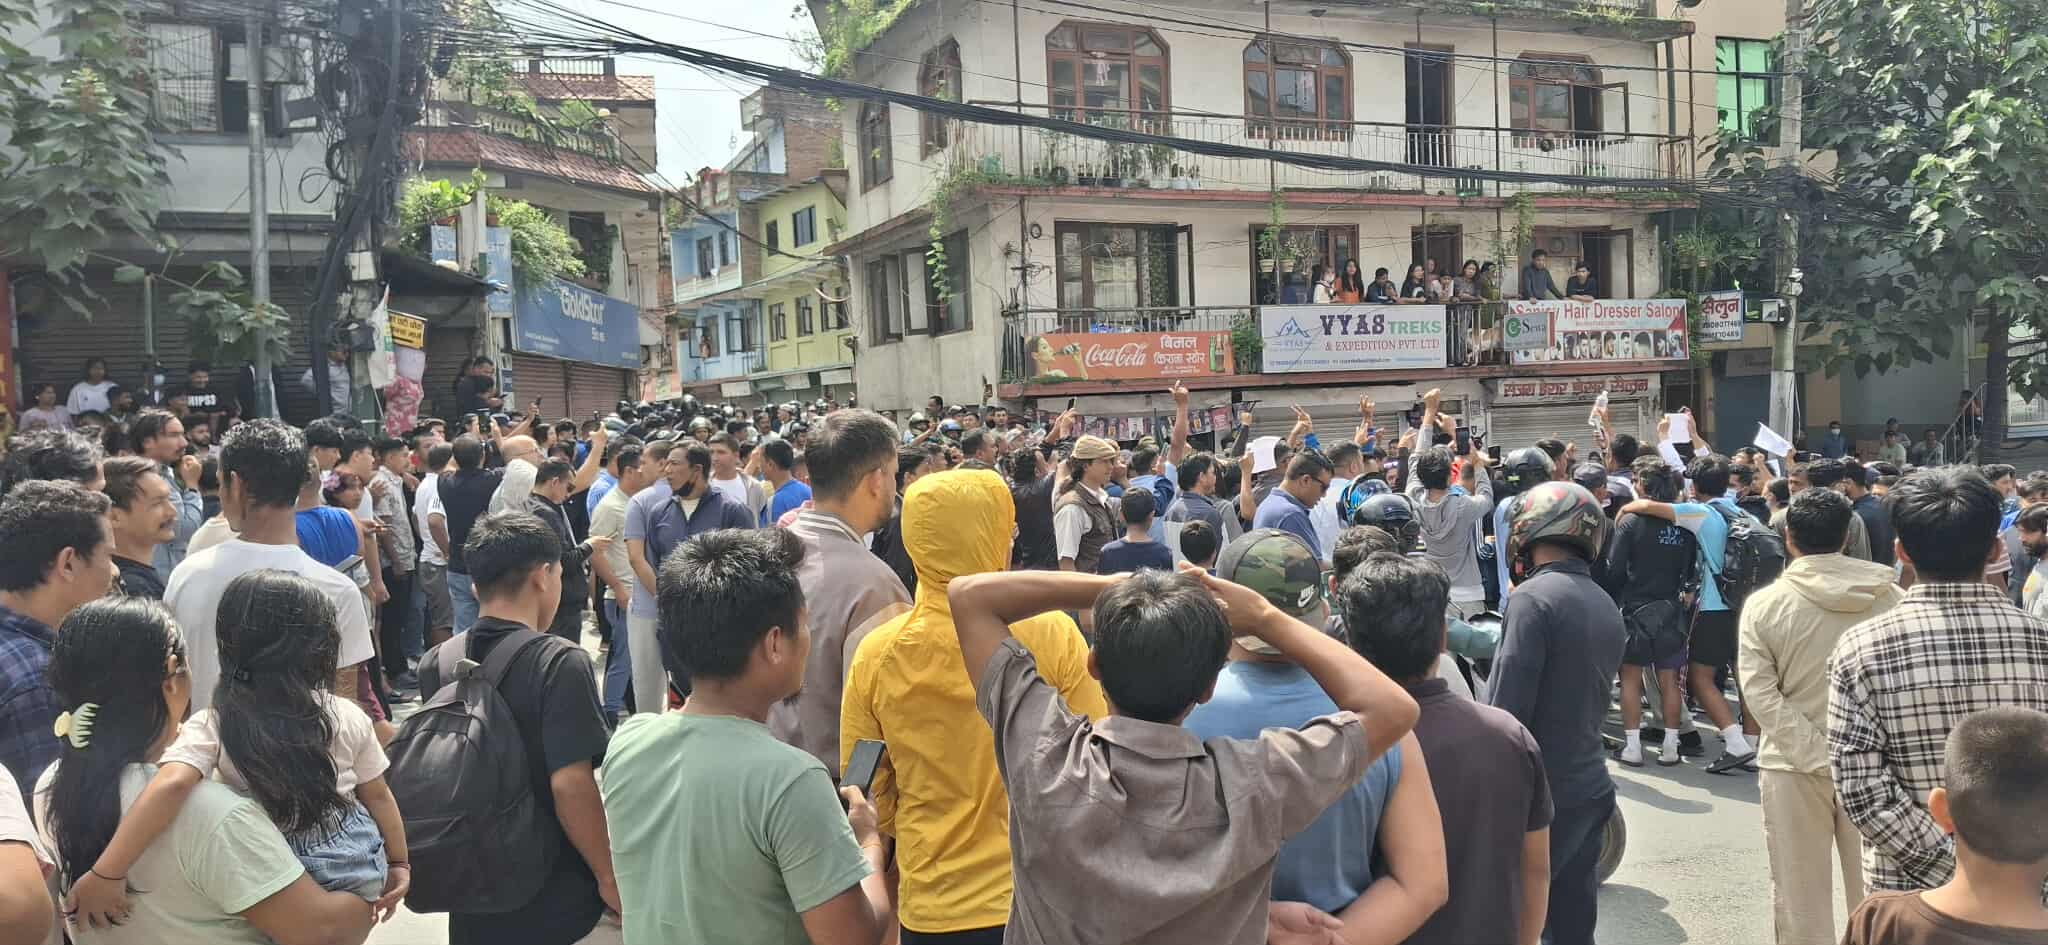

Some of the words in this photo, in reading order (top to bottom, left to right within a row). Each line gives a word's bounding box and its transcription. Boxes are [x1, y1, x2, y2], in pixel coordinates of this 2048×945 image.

[1564, 303, 1590, 320] Hair
[1594, 303, 1641, 319] Dresser
[1646, 302, 1680, 318] Salon
[1319, 313, 1385, 336] VYAS
[1388, 320, 1442, 334] TREKS
[1160, 334, 1198, 350] बिमल
[1335, 340, 1396, 352] EXPEDITION
